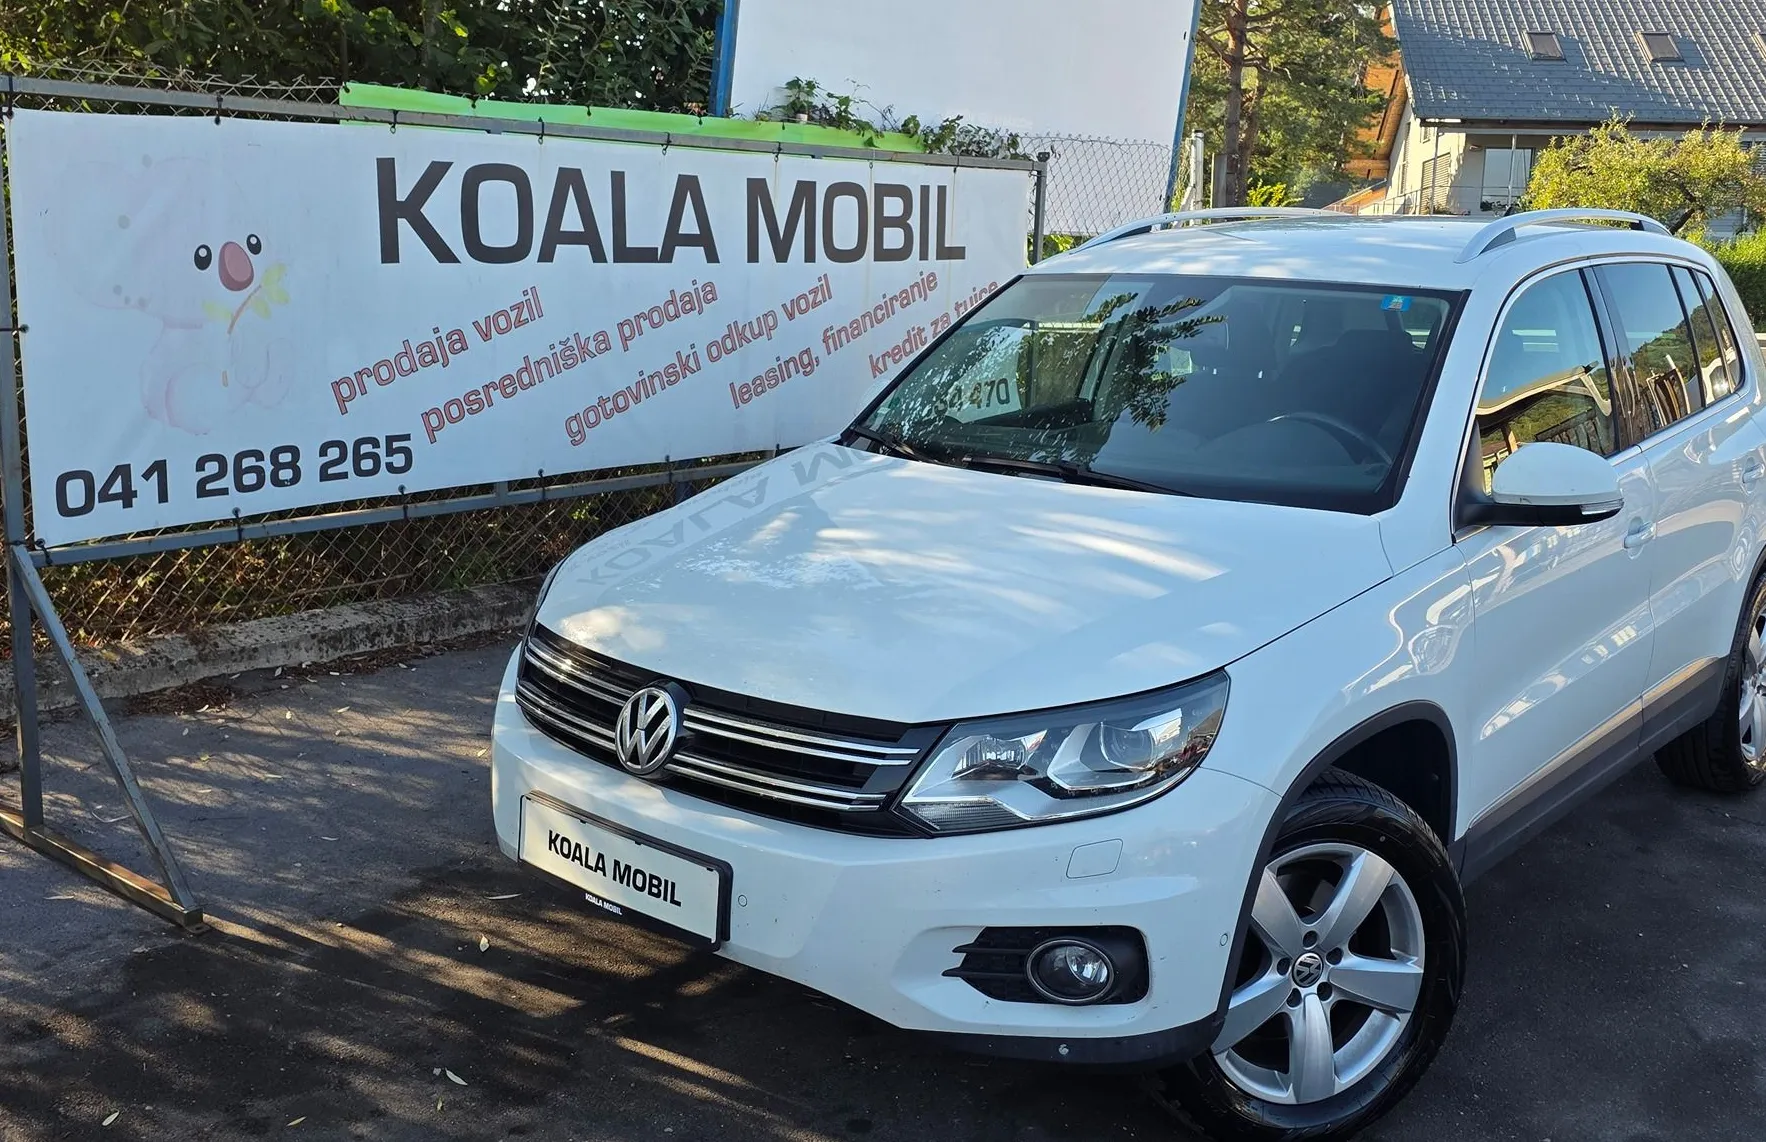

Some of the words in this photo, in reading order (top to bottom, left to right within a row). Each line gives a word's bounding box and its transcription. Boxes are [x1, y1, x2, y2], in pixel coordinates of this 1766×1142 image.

[376, 157, 720, 264] KOALA
[746, 177, 966, 264] MOBIL
[331, 326, 469, 415] prodaja
[473, 286, 544, 342] vozil
[421, 326, 610, 444] posredniška
[617, 278, 718, 352] prodaja
[564, 342, 701, 446] gotovinski
[706, 308, 778, 363] odkup
[781, 274, 833, 318] vozil
[729, 347, 820, 410] leasing,
[822, 270, 939, 357] financiranje
[868, 326, 928, 379] kredit
[930, 312, 953, 338] za
[55, 458, 169, 518] 041
[195, 444, 302, 499] 268
[318, 433, 413, 483] 265
[548, 829, 607, 877] KOALA
[612, 859, 682, 908] MOBIL
[585, 892, 603, 907] KOALA
[603, 901, 623, 915] MOBIL
